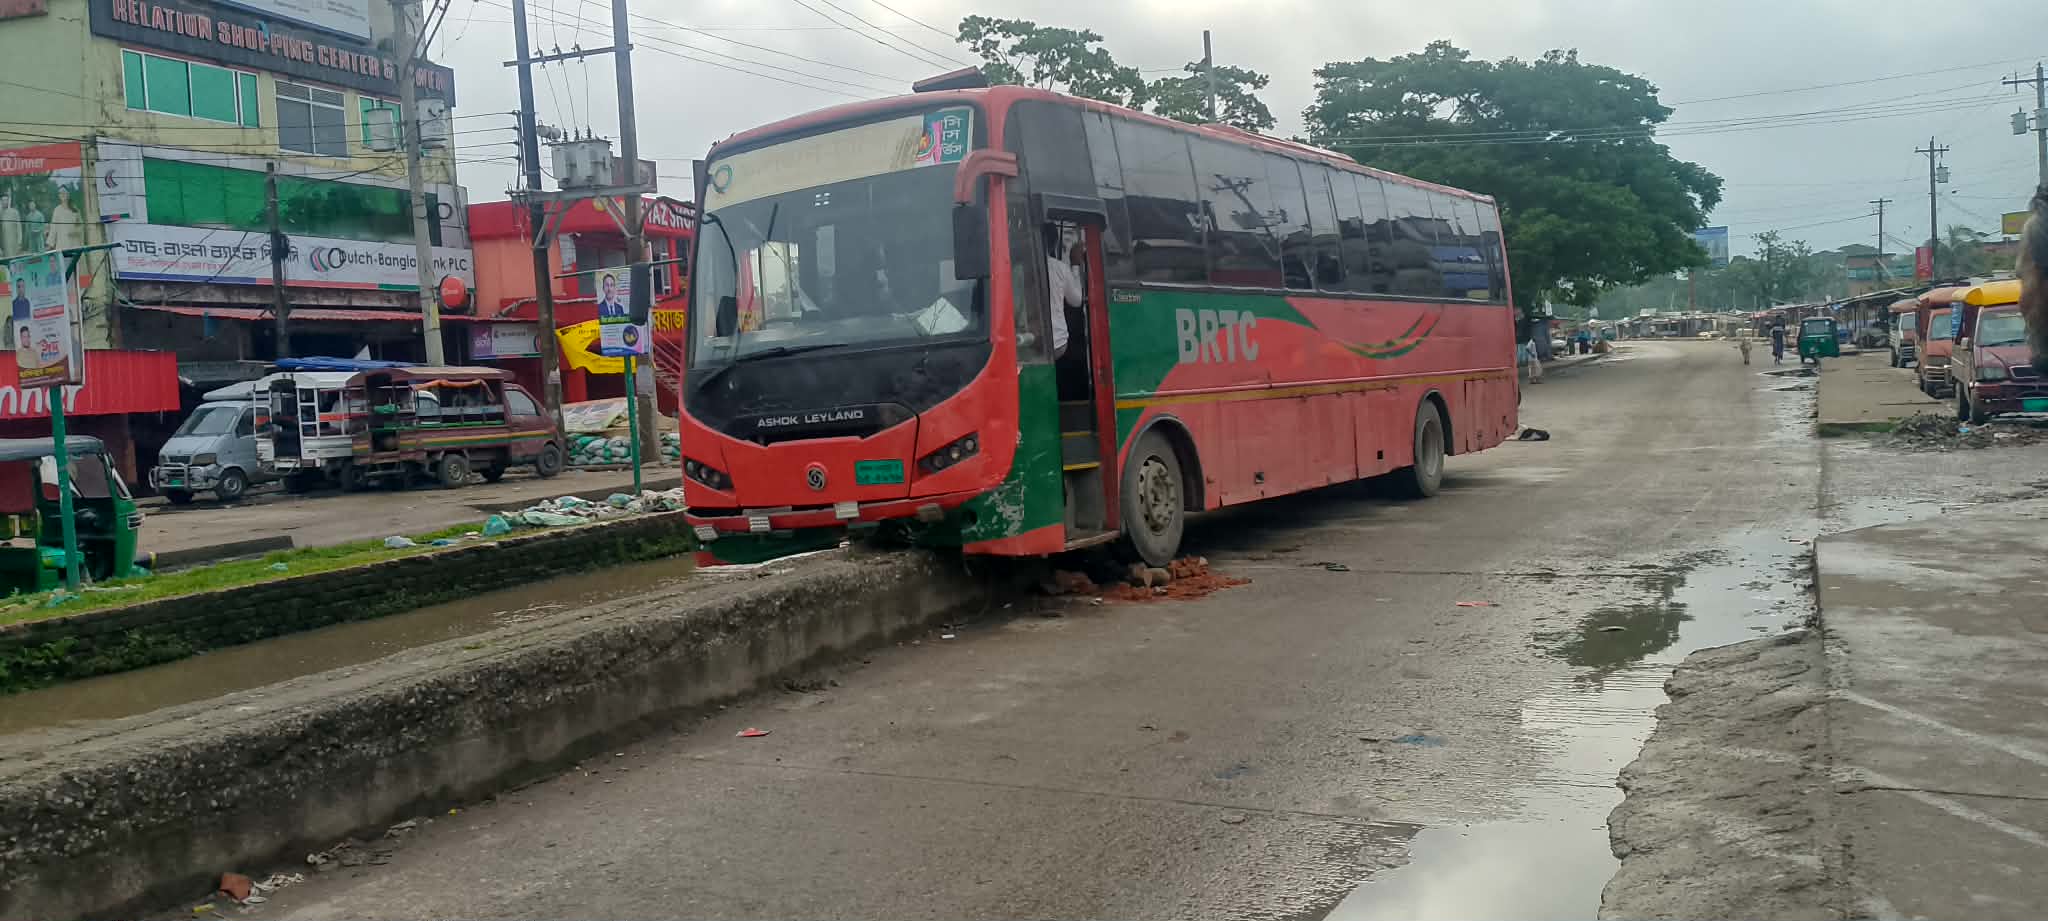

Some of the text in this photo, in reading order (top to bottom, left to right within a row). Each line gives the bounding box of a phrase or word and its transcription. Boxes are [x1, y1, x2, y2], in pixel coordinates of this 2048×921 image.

[113, 0, 213, 41] RELATION
[318, 45, 380, 79] CENTER
[449, 257, 468, 272] PLC
[1175, 308, 1259, 365] BRTC
[757, 408, 864, 428] ASHOK LEYLAND
